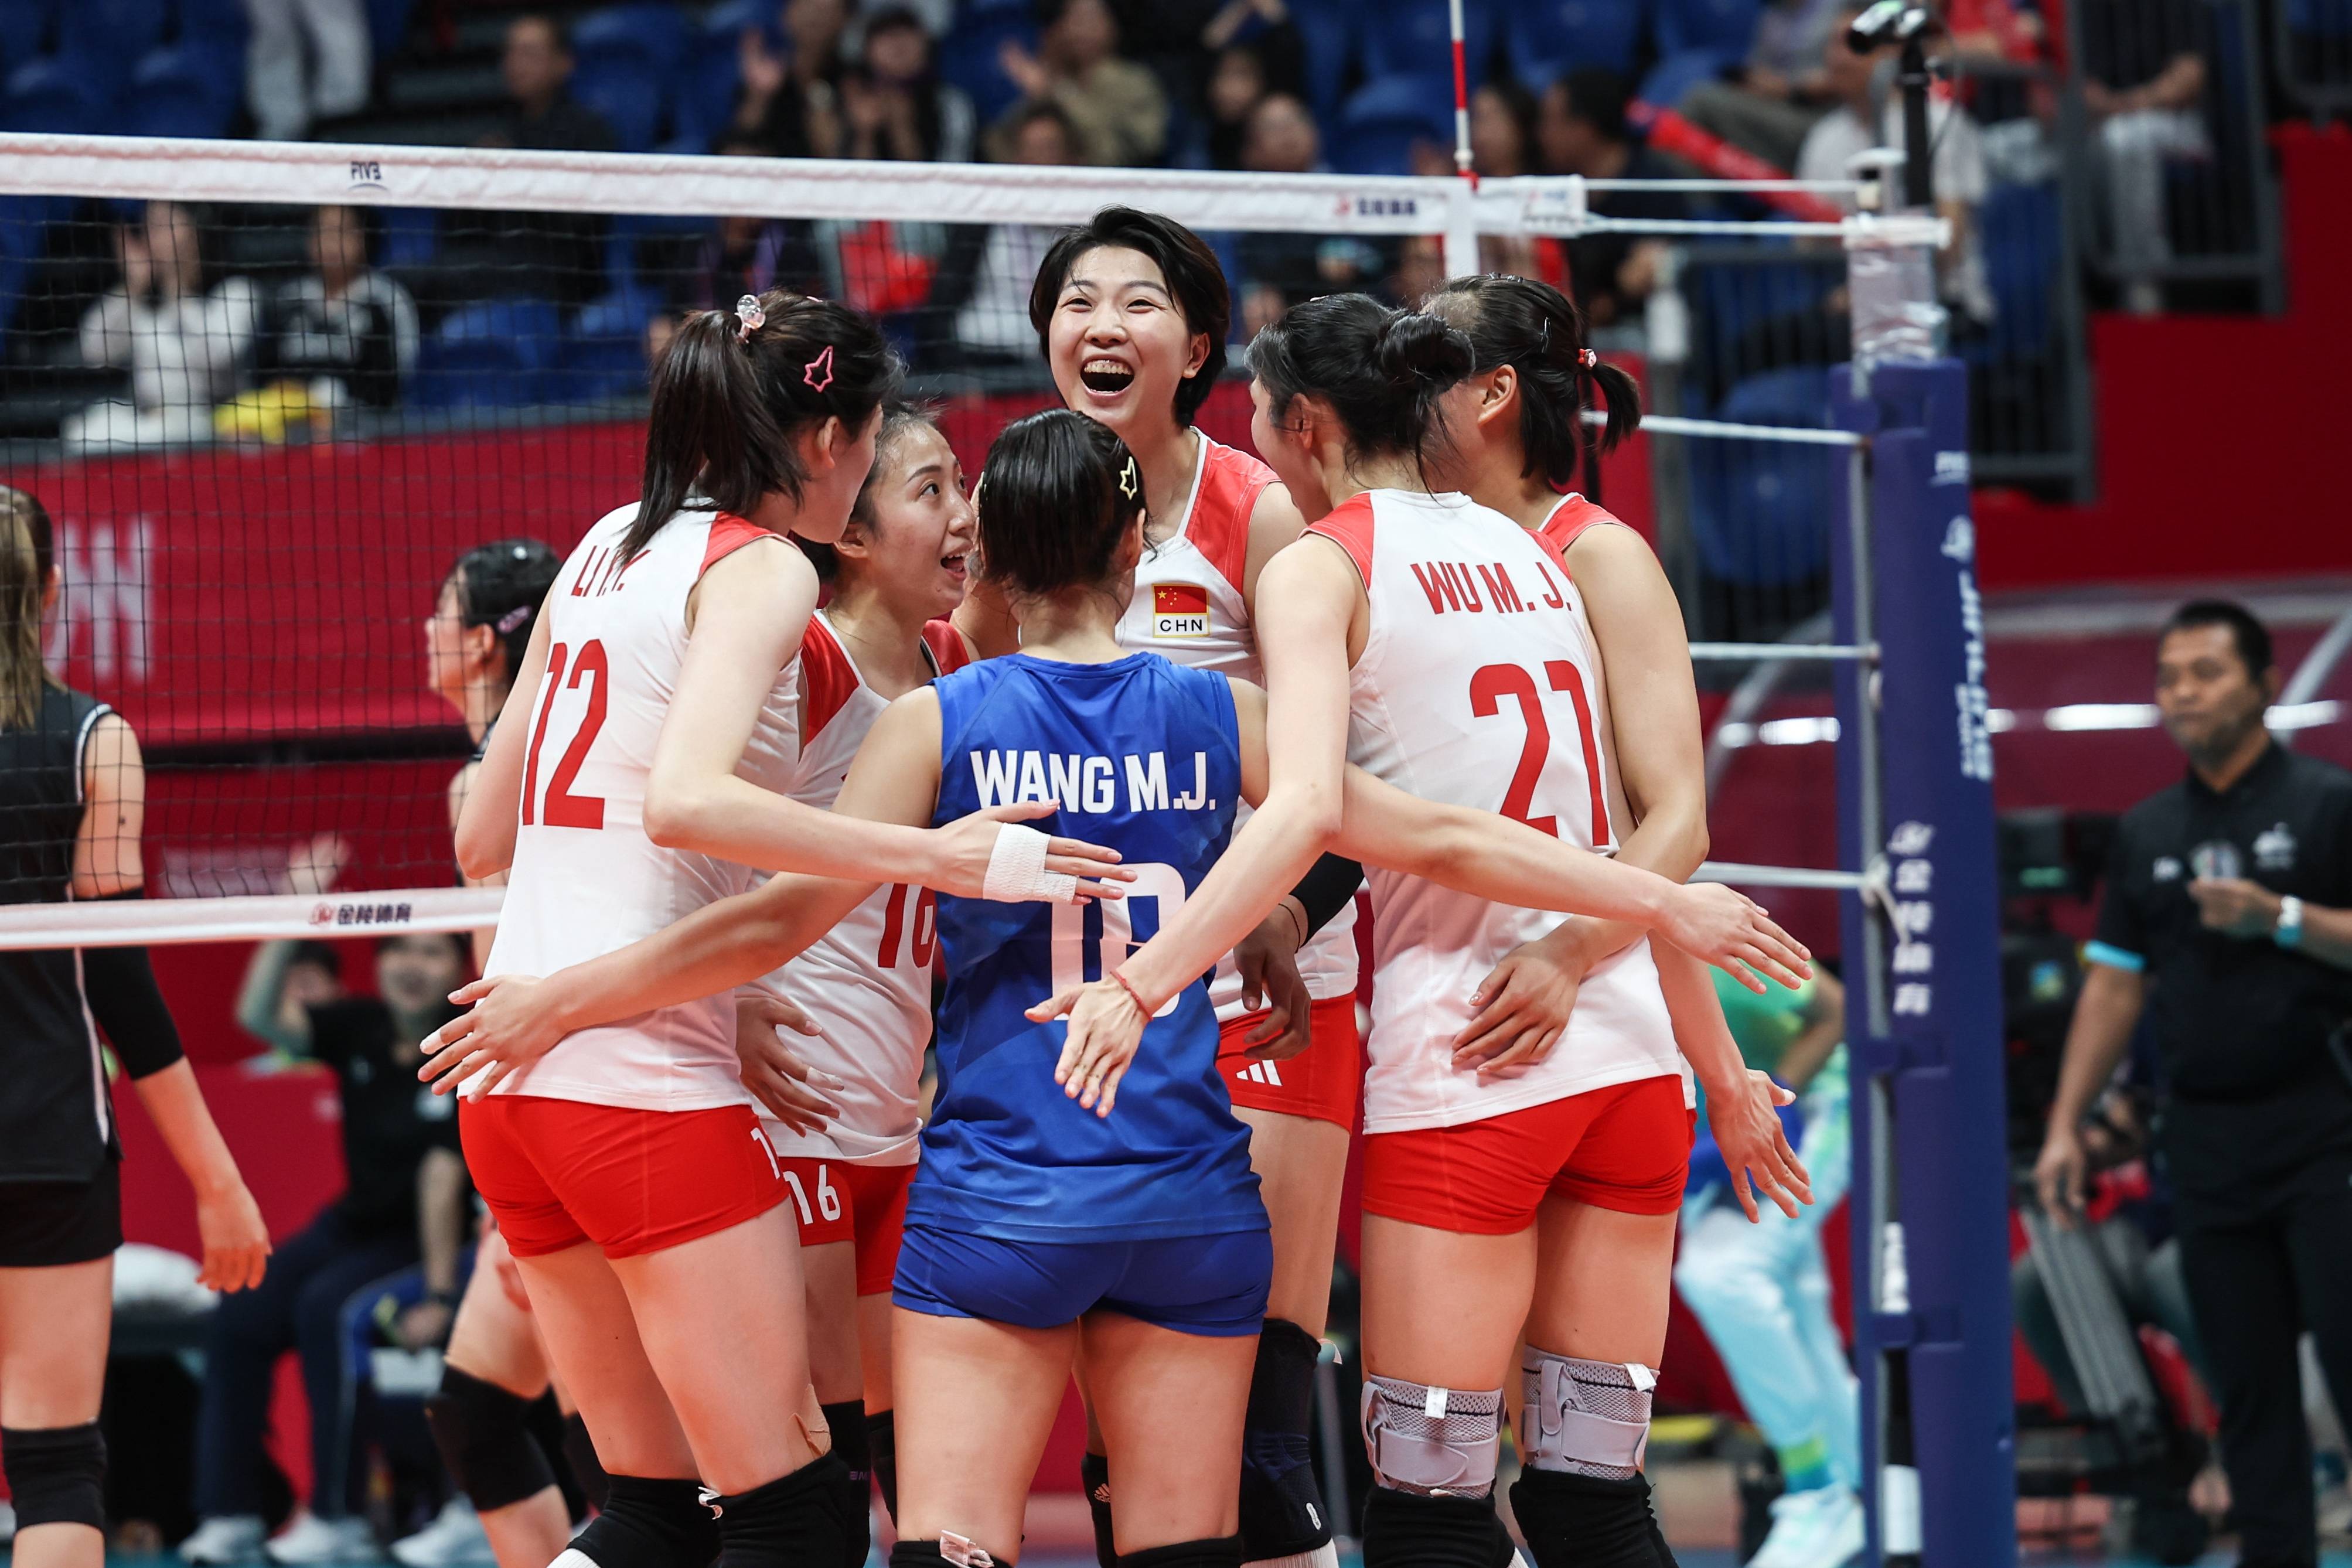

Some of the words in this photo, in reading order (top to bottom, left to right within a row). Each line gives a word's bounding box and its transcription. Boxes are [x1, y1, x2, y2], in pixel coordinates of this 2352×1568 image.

[351, 161, 381, 179] FIVB
[571, 545, 609, 596] LI
[1410, 561, 1483, 614] WU
[1160, 619, 1202, 632] CHN
[523, 639, 608, 829] 12
[1470, 660, 1609, 846] 21
[970, 749, 1114, 813] WANG
[1124, 751, 1216, 813] M.J.
[783, 1164, 841, 1225] 16
